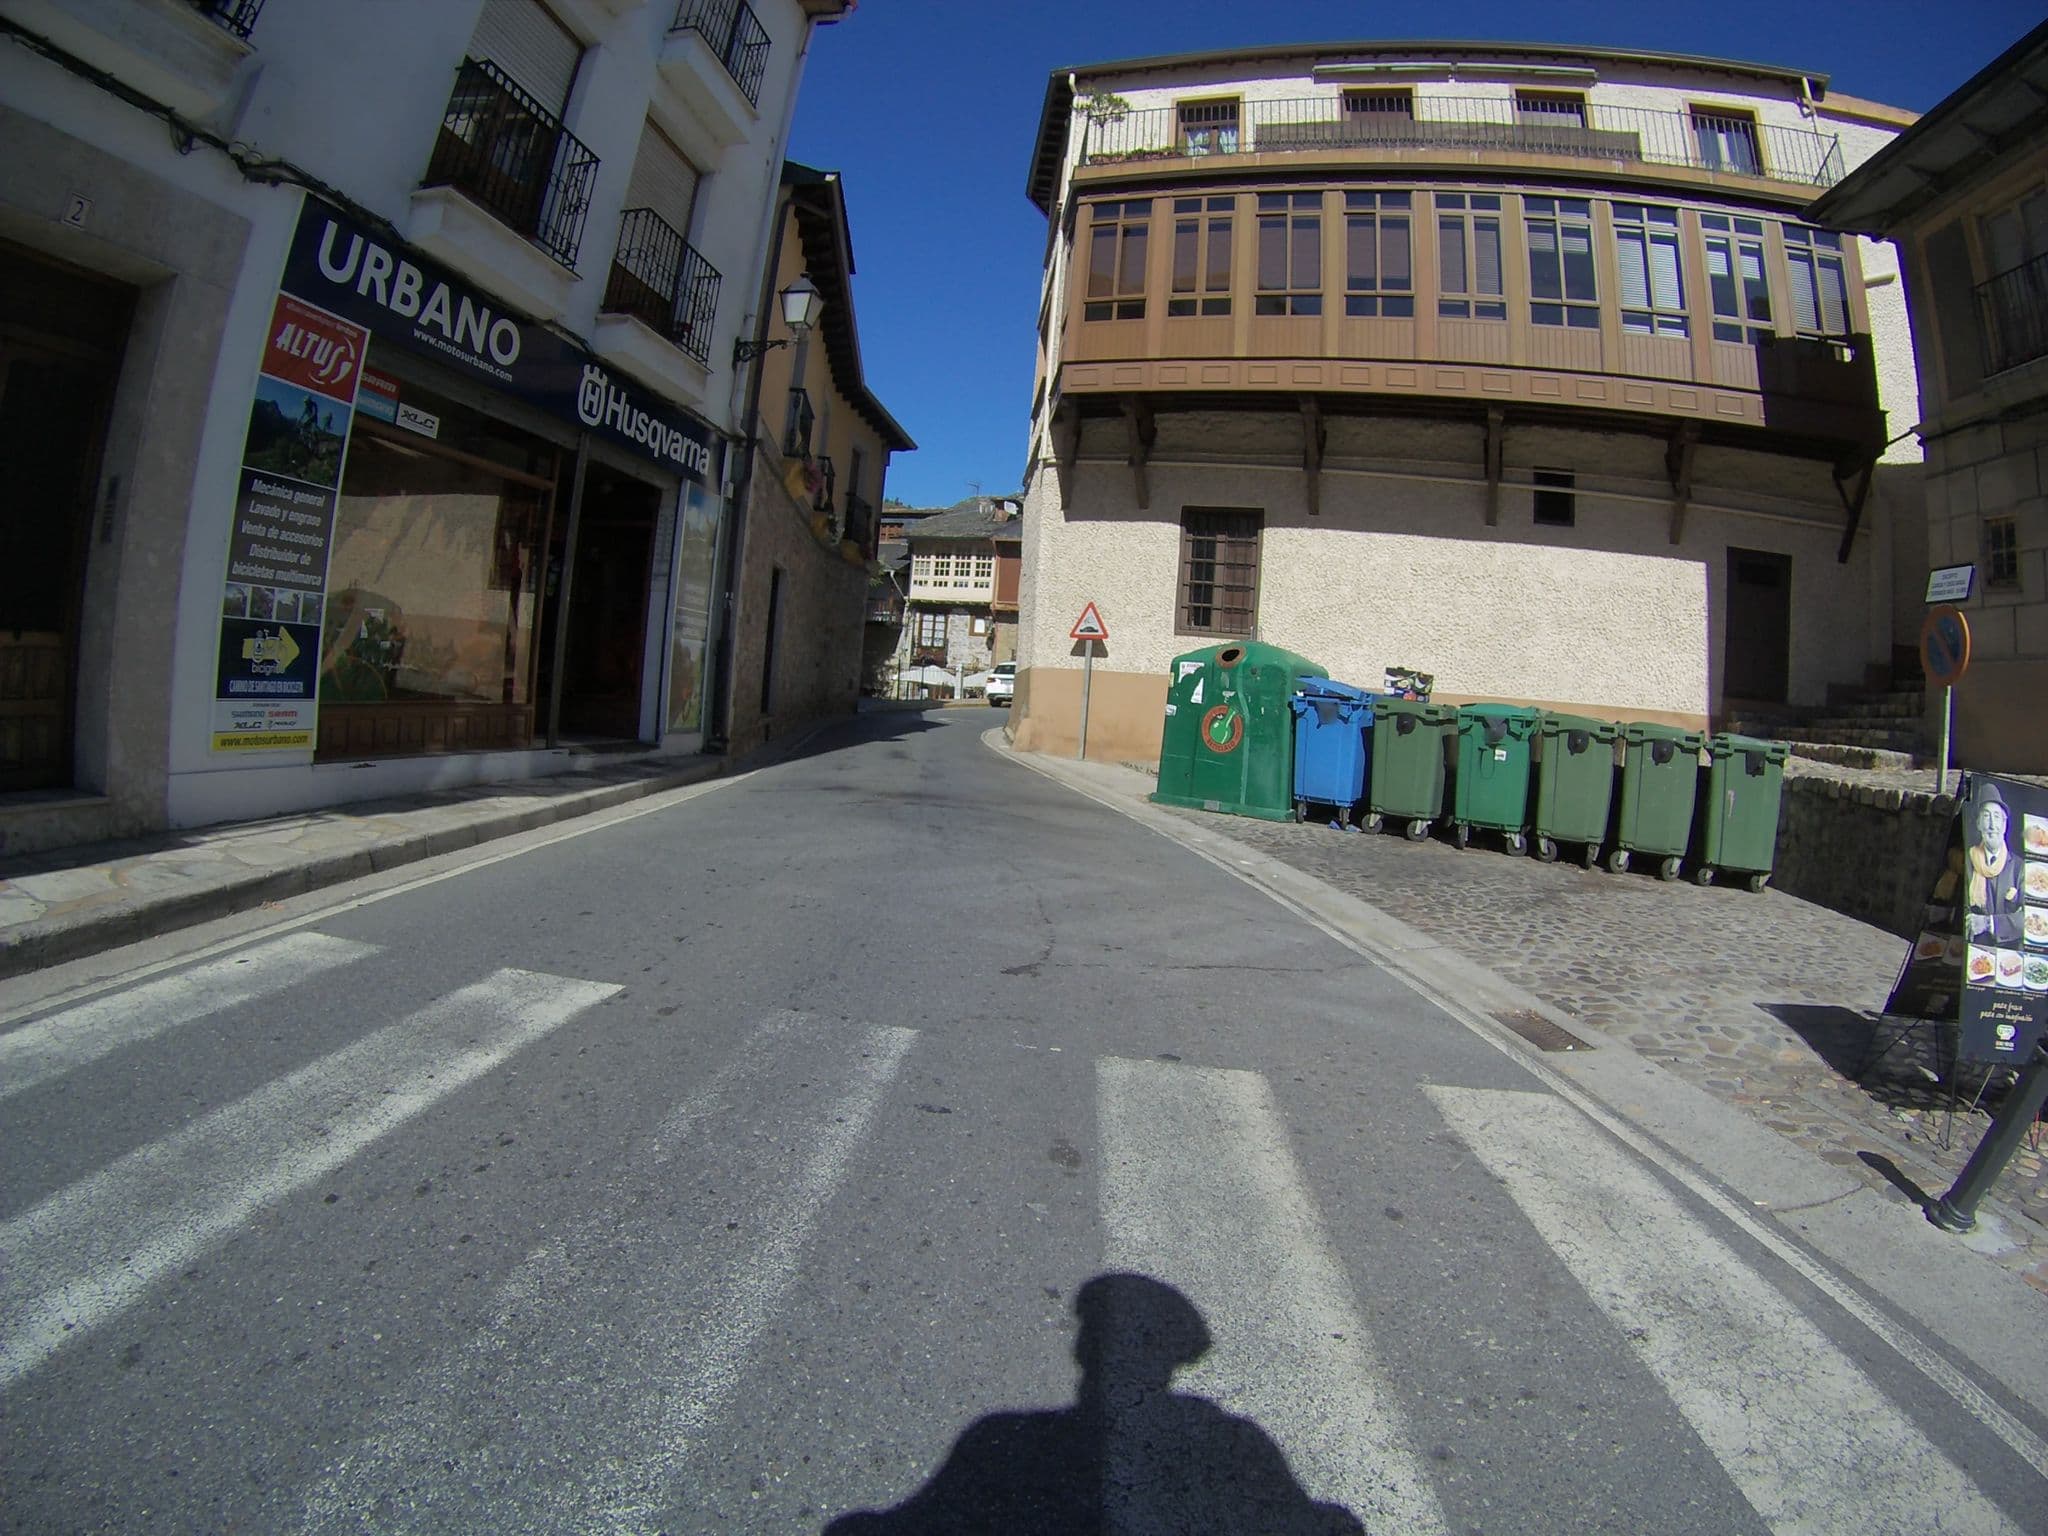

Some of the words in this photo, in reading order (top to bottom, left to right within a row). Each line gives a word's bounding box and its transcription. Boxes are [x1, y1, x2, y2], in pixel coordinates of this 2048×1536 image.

[72, 200, 84, 222] 2
[317, 219, 520, 367] URBANO
[413, 328, 513, 383] www.motosurbano.com
[605, 384, 711, 477] Husqvarna
[251, 478, 294, 500] Mecánica
[293, 491, 326, 507] general
[249, 499, 281, 519] Lavado
[280, 509, 289, 522] y
[288, 510, 322, 527] engrase
[241, 519, 267, 537] Venta
[267, 525, 280, 539] de
[249, 543, 300, 563] Distribuidor
[299, 552, 312, 566] de
[232, 560, 275, 580] bicicletas
[275, 568, 322, 586] multimarca
[219, 735, 309, 748] www.motosurbano.com
